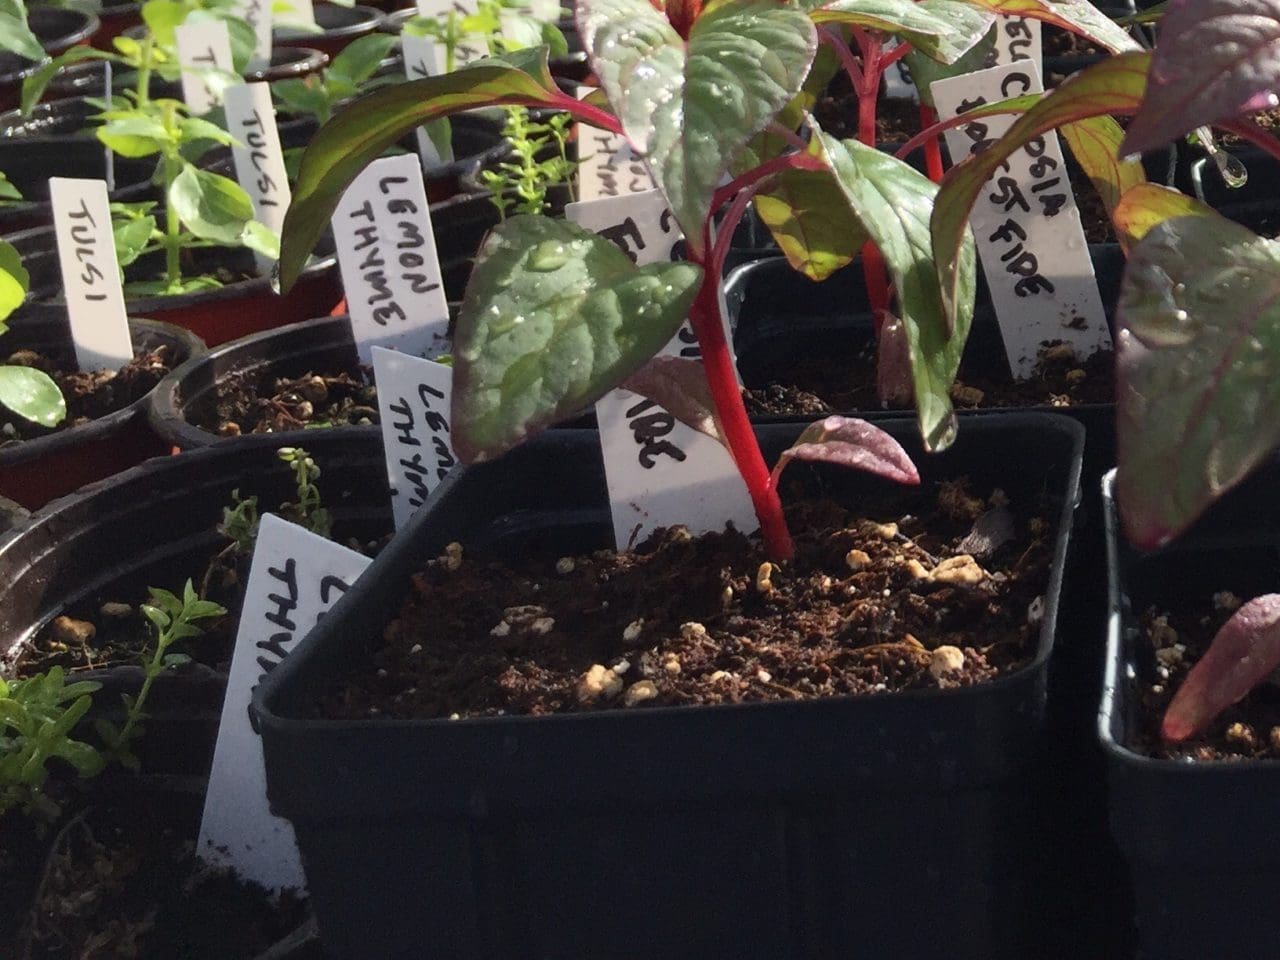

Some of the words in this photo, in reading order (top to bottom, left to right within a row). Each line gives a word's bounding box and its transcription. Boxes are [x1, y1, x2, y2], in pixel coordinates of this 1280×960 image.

[242, 109, 278, 207] TULSI
[1001, 71, 1067, 218] COSIA
[68, 198, 107, 302] TULSI
[350, 200, 407, 327] THYME
[379, 176, 440, 294] LEMON
